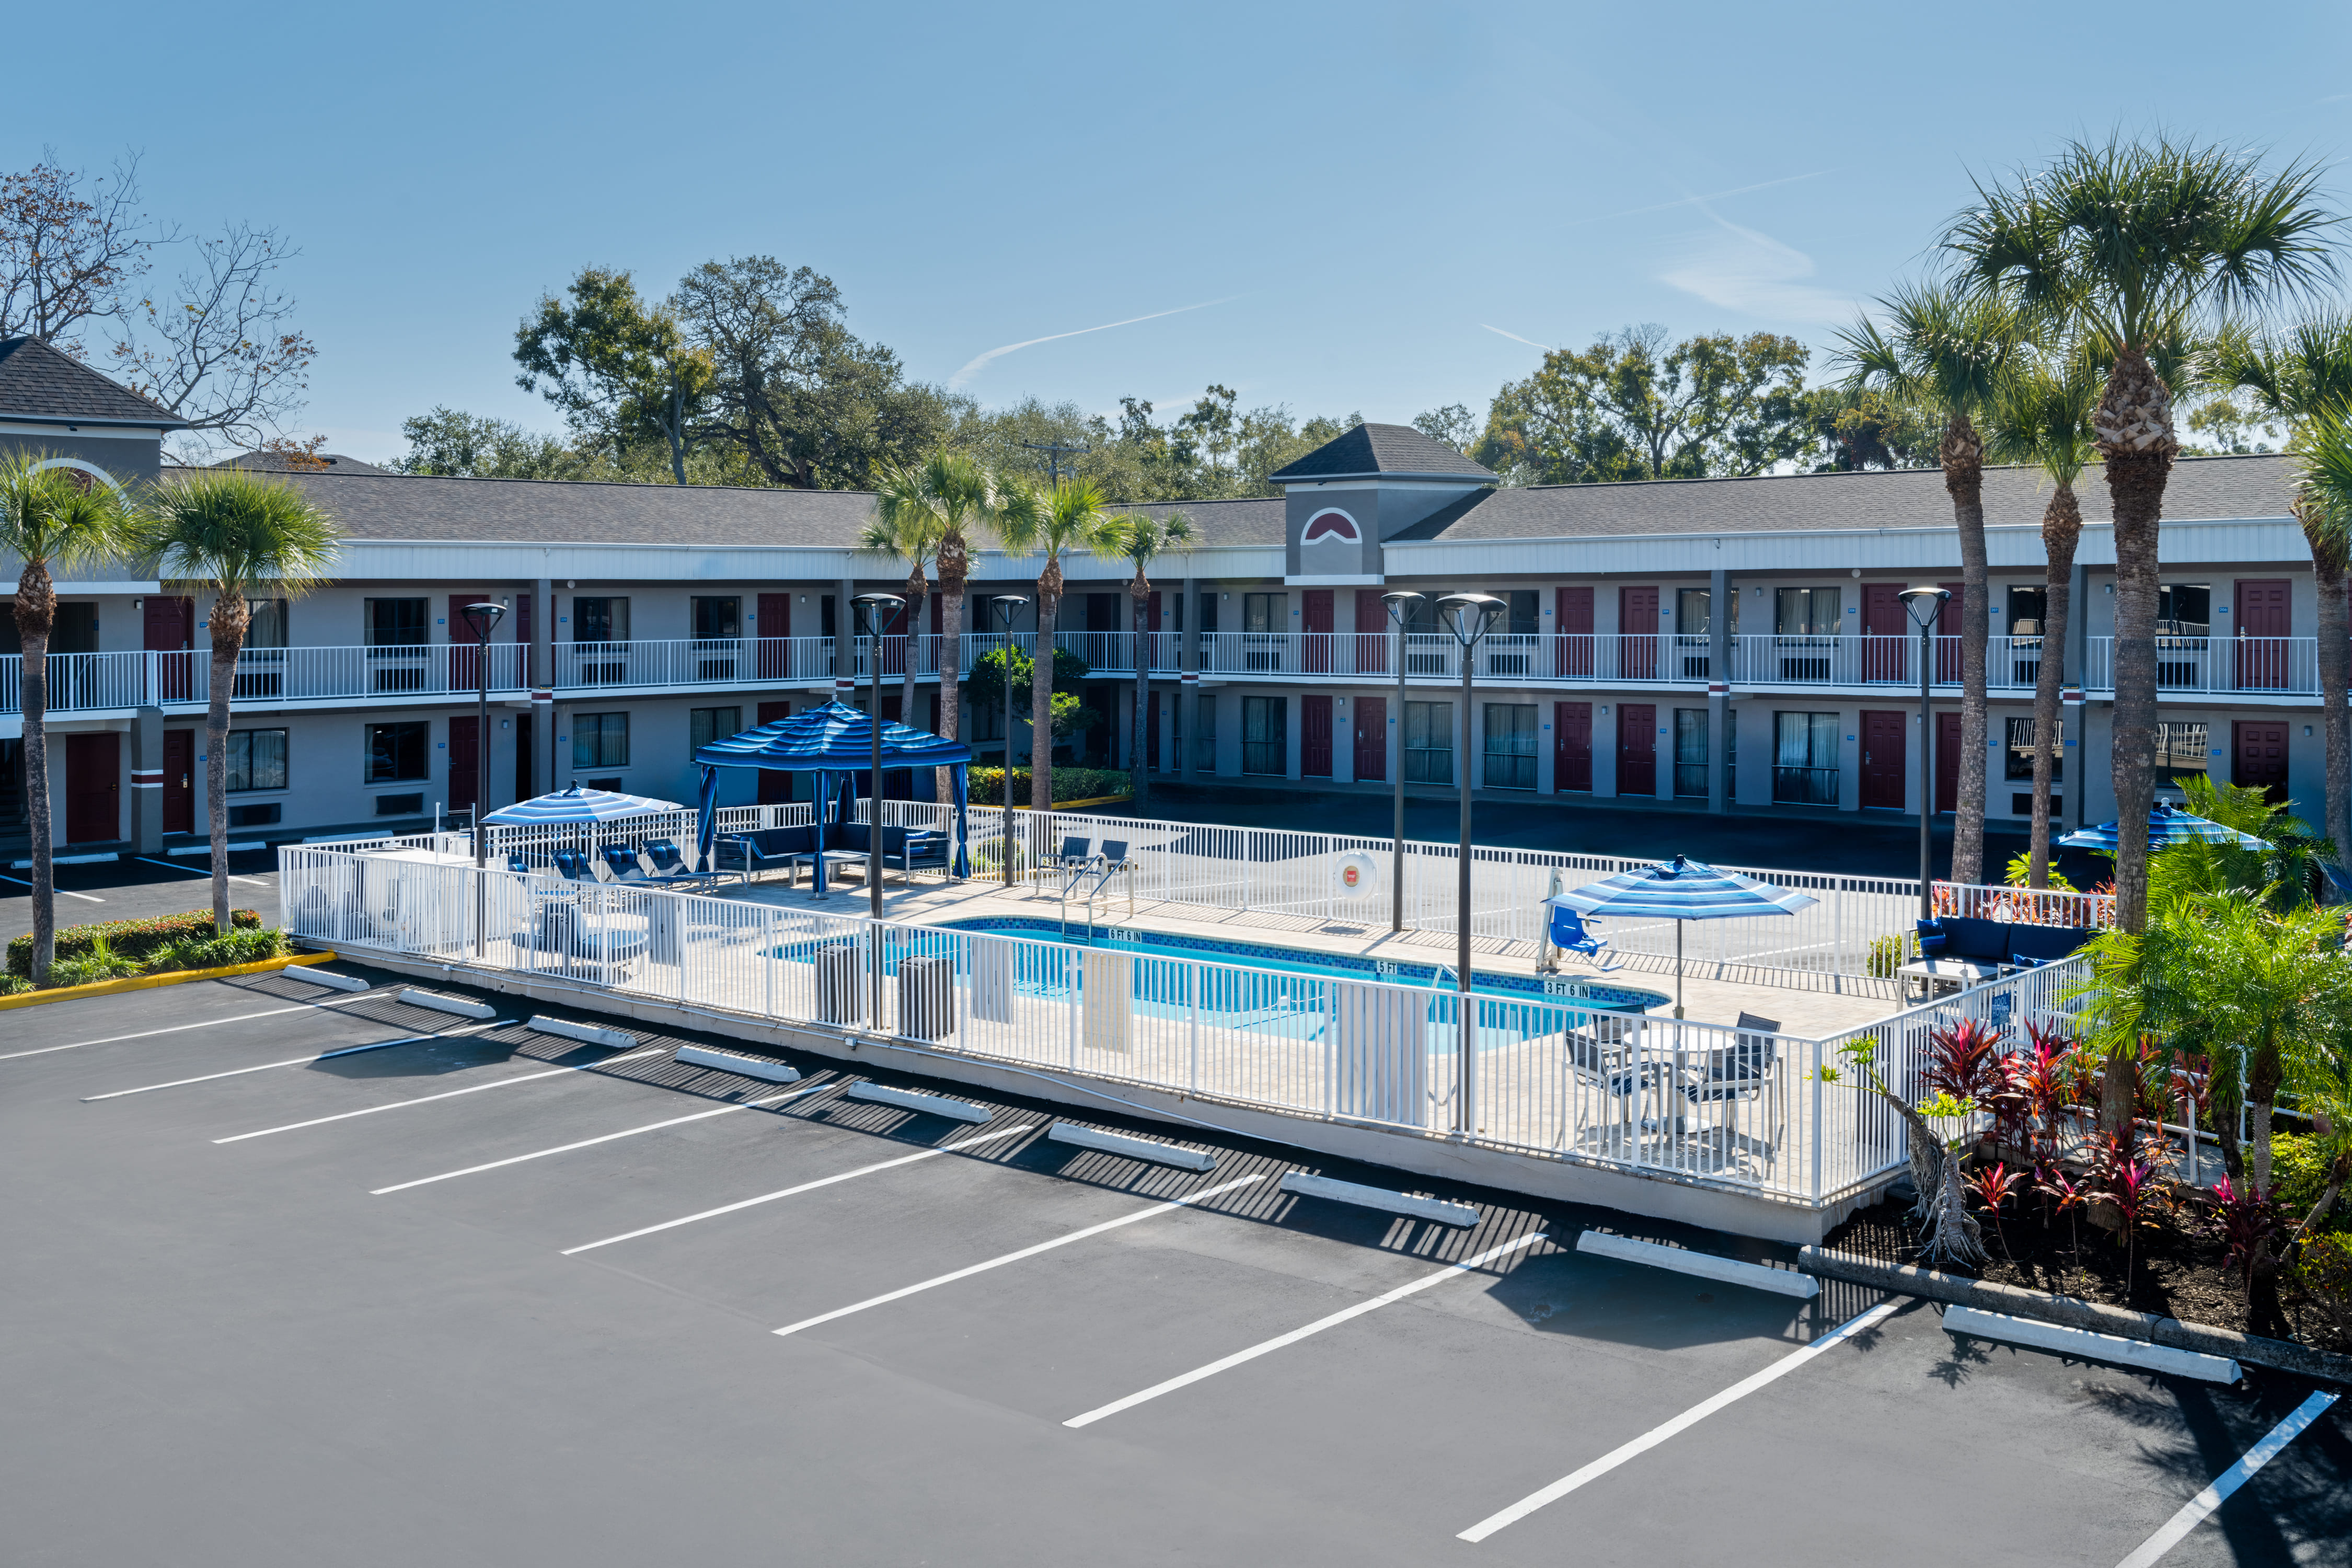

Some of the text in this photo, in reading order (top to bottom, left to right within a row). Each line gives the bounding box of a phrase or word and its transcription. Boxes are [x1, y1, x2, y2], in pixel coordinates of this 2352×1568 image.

[1111, 929, 1140, 942] 6 FT 6 IN
[1380, 962, 1397, 974] 5 FT
[1548, 983, 1588, 998] 3 FT 6 IN
[1994, 996, 2007, 1007] POOL
[1992, 1005, 2009, 1018] HOURS
